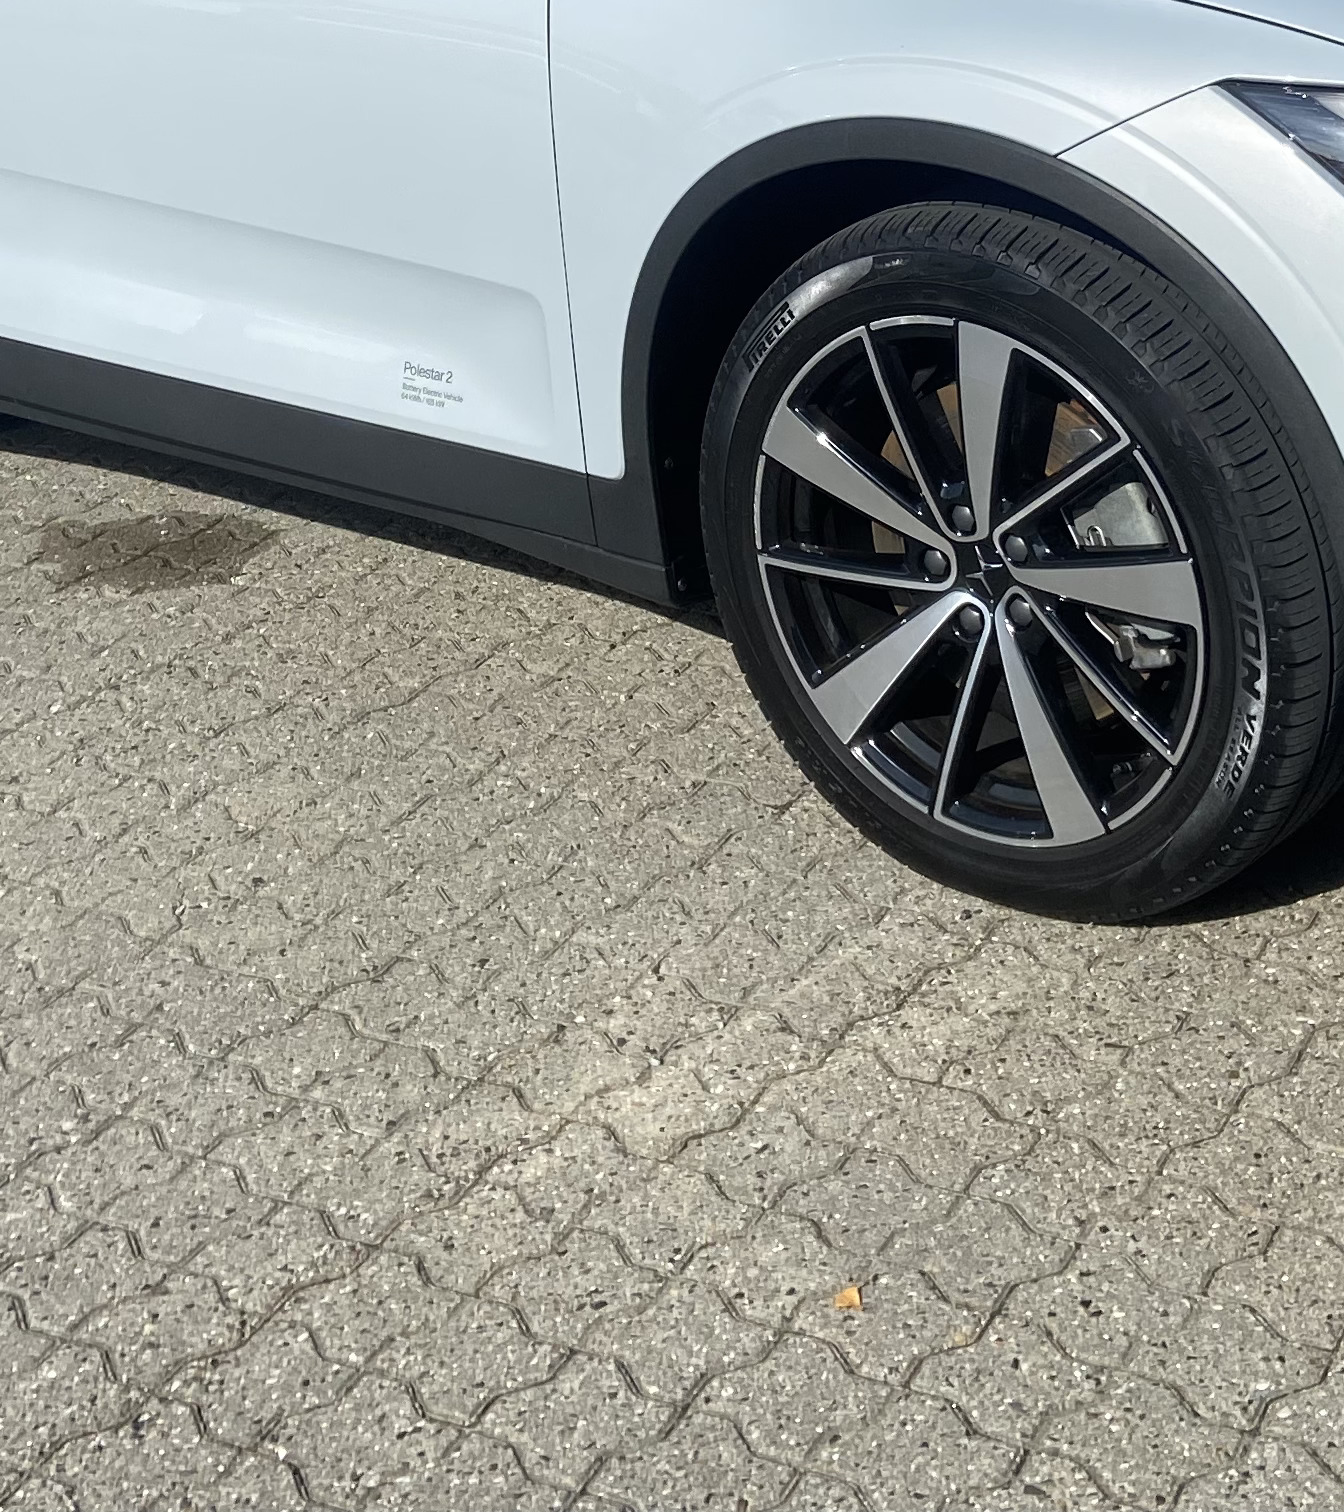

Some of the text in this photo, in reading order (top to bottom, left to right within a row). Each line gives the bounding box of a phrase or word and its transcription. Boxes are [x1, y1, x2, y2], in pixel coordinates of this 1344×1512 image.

[403, 361, 453, 384] Polestar 2
[742, 301, 796, 373] PIRELLI
[1222, 713, 1257, 800] VERDE
